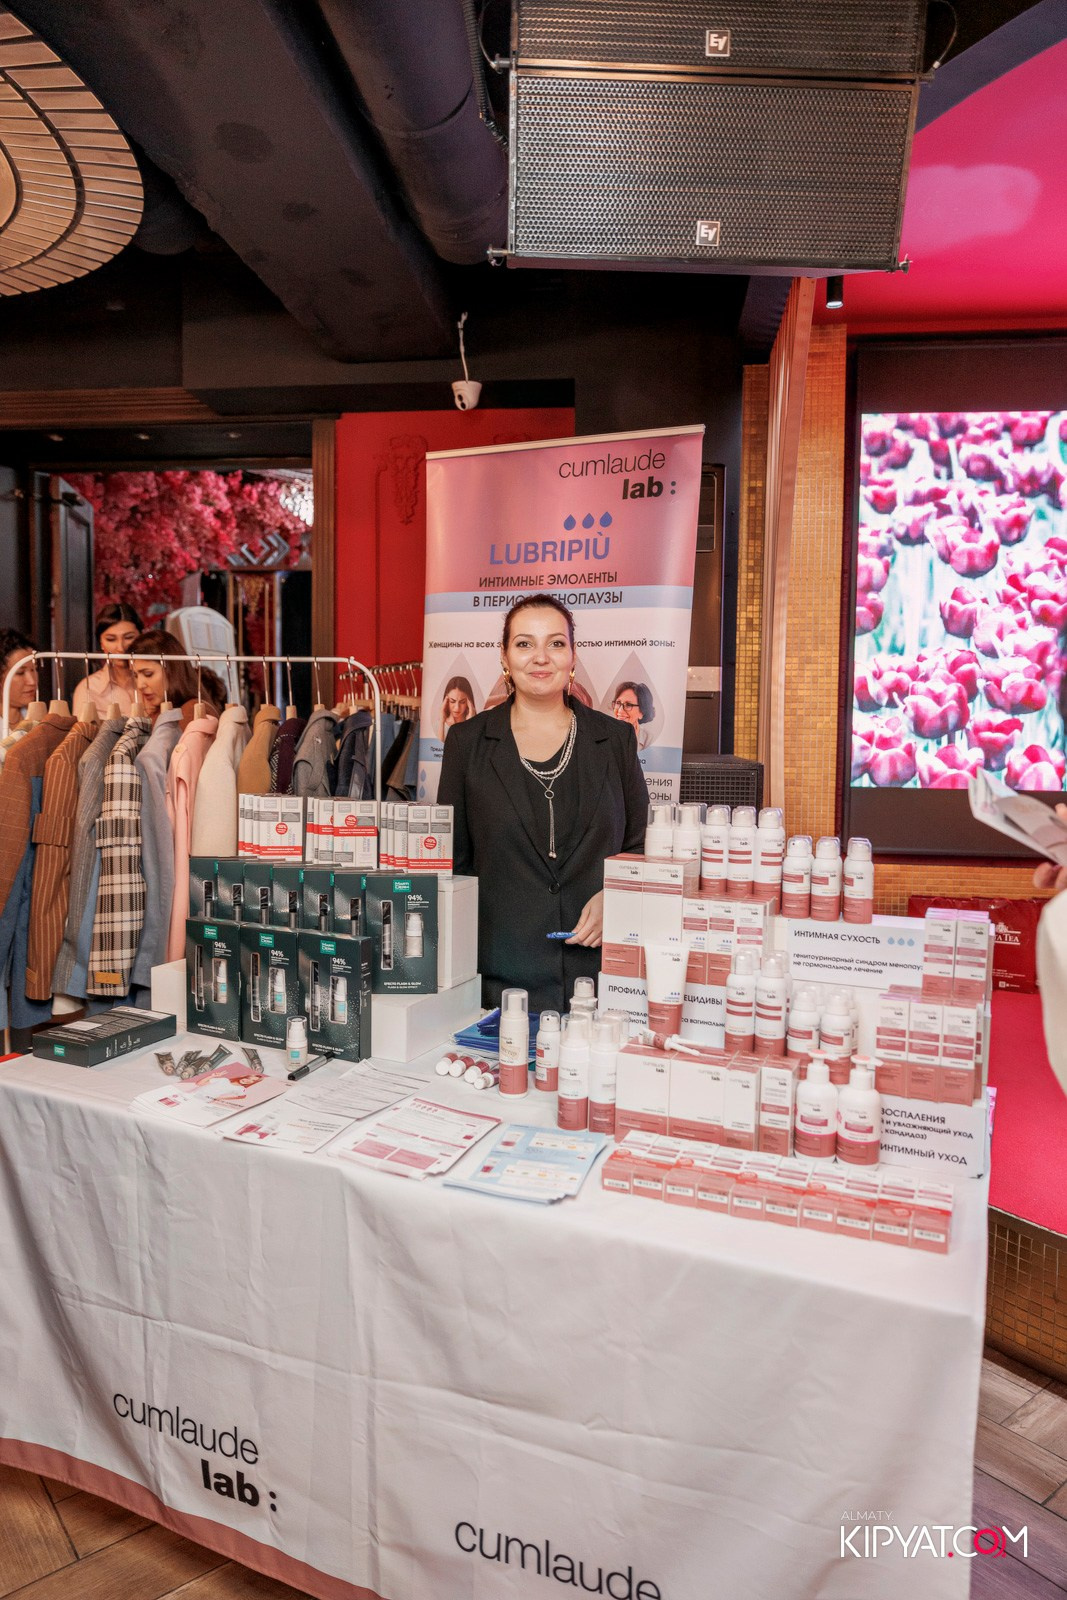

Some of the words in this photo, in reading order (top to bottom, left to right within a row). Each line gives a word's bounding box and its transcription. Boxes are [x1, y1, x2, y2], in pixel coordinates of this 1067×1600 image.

[558, 449, 666, 478] cumlaude
[489, 531, 611, 565] LUBRIPIÙ
[479, 574, 544, 588] ИНТИМНЫЕ
[546, 571, 618, 585] ЭМОЛЕНТЫ
[473, 596, 480, 607] В
[483, 594, 525, 607] ПЕРИО
[551, 591, 623, 606] НОПАУЗЫ
[428, 641, 463, 649] Женщины
[604, 638, 647, 647] интимной
[648, 640, 676, 648] зоны:
[645, 777, 673, 787] ения
[794, 930, 839, 941] ИНТИМНАЯ
[840, 934, 881, 944] СУХОСТЬ
[214, 941, 227, 949] 94%
[270, 949, 284, 957] 94%
[793, 953, 854, 964] генитоуринарный
[855, 959, 888, 967] синдром
[332, 957, 347, 965] 94%
[802, 962, 852, 971] гормональное
[608, 985, 648, 996] ПРОФИЛА
[683, 994, 723, 1005] ЕЦИДИВЫ
[689, 1019, 726, 1028] вагинальн
[885, 1128, 928, 1140] кандидоз)
[892, 1120, 951, 1134] увлажняющий
[952, 1131, 974, 1139] уход
[880, 1143, 936, 1159] ИНТИМНЫЙ
[937, 1152, 968, 1166] УХОД
[112, 1393, 259, 1465] cumlaude
[454, 1521, 661, 1600] cumlaude
